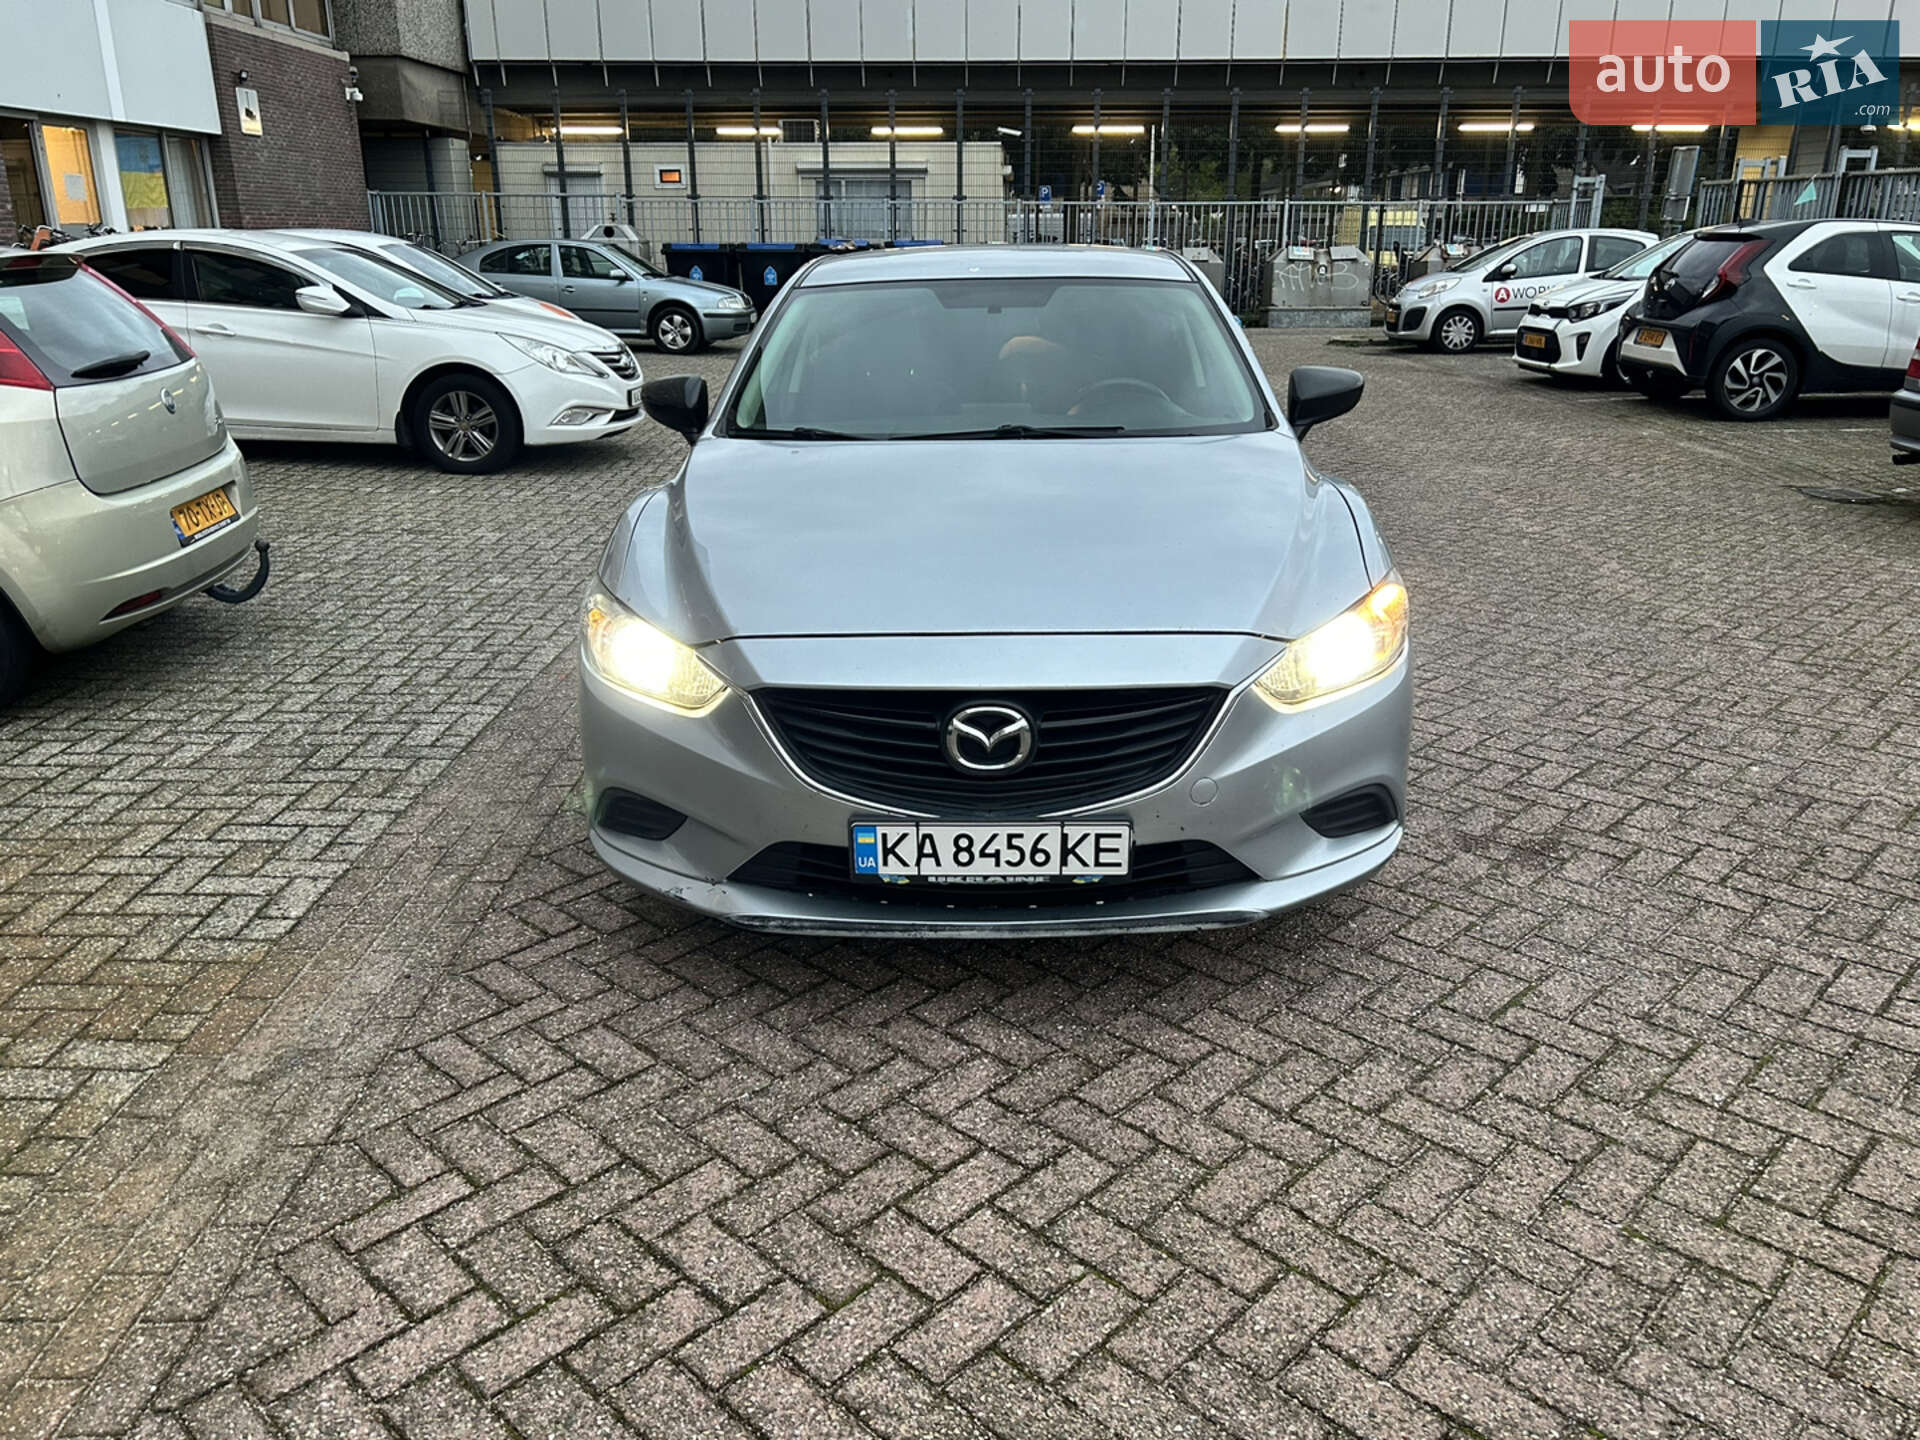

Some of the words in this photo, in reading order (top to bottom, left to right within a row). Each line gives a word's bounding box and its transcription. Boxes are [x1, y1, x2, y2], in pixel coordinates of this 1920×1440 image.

[1512, 286, 1552, 299] WOR
[881, 832, 942, 868] KA
[952, 832, 1051, 868] 8456
[1062, 832, 1123, 868] KE
[858, 857, 876, 868] UA
